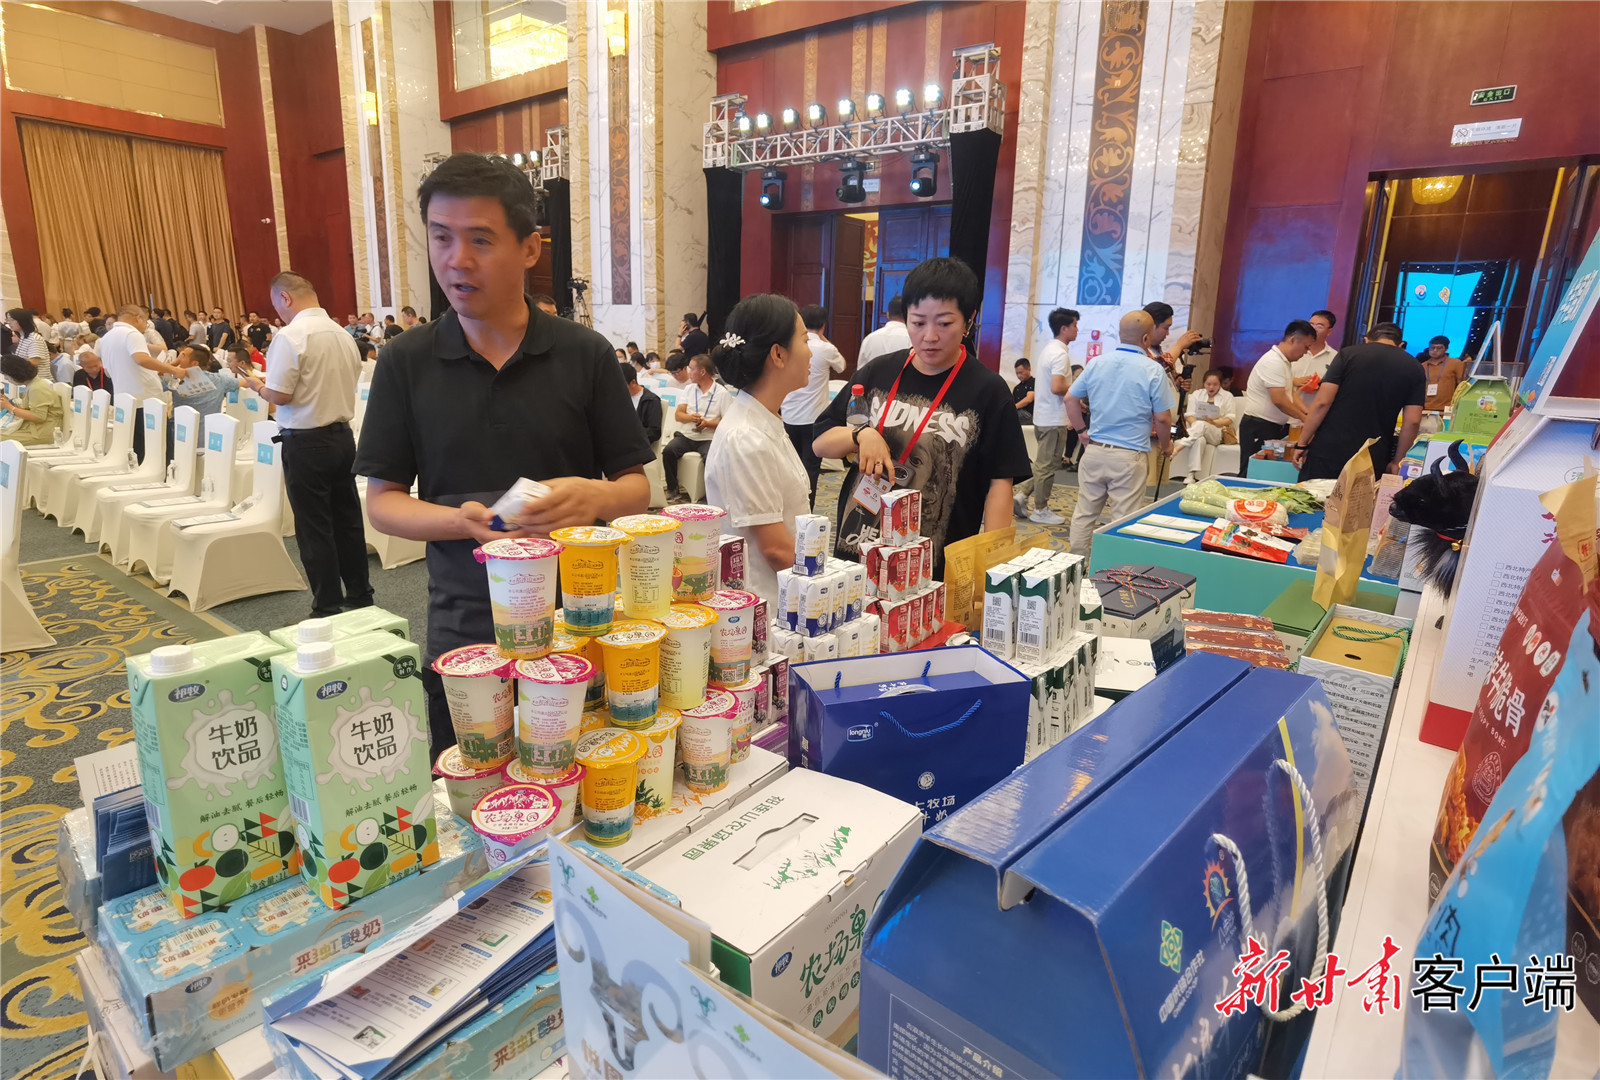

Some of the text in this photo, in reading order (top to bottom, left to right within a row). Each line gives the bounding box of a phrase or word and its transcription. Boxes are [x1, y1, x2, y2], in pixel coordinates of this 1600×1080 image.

[1478, 89, 1511, 99] 安全出口
[208, 715, 259, 746] 牛奶
[350, 711, 394, 741] 牛奶
[211, 739, 262, 772] 饮品
[353, 735, 397, 766] 饮品
[200, 789, 285, 824] 解油去腻 餐后轻畅
[345, 783, 418, 818] 解油去腻 餐后轻畅
[483, 810, 540, 824] 农场果园
[681, 795, 785, 861] 祁连山农场果园
[295, 917, 382, 975] 彩虹酸奶
[962, 1045, 1004, 1079] 产品介绍
